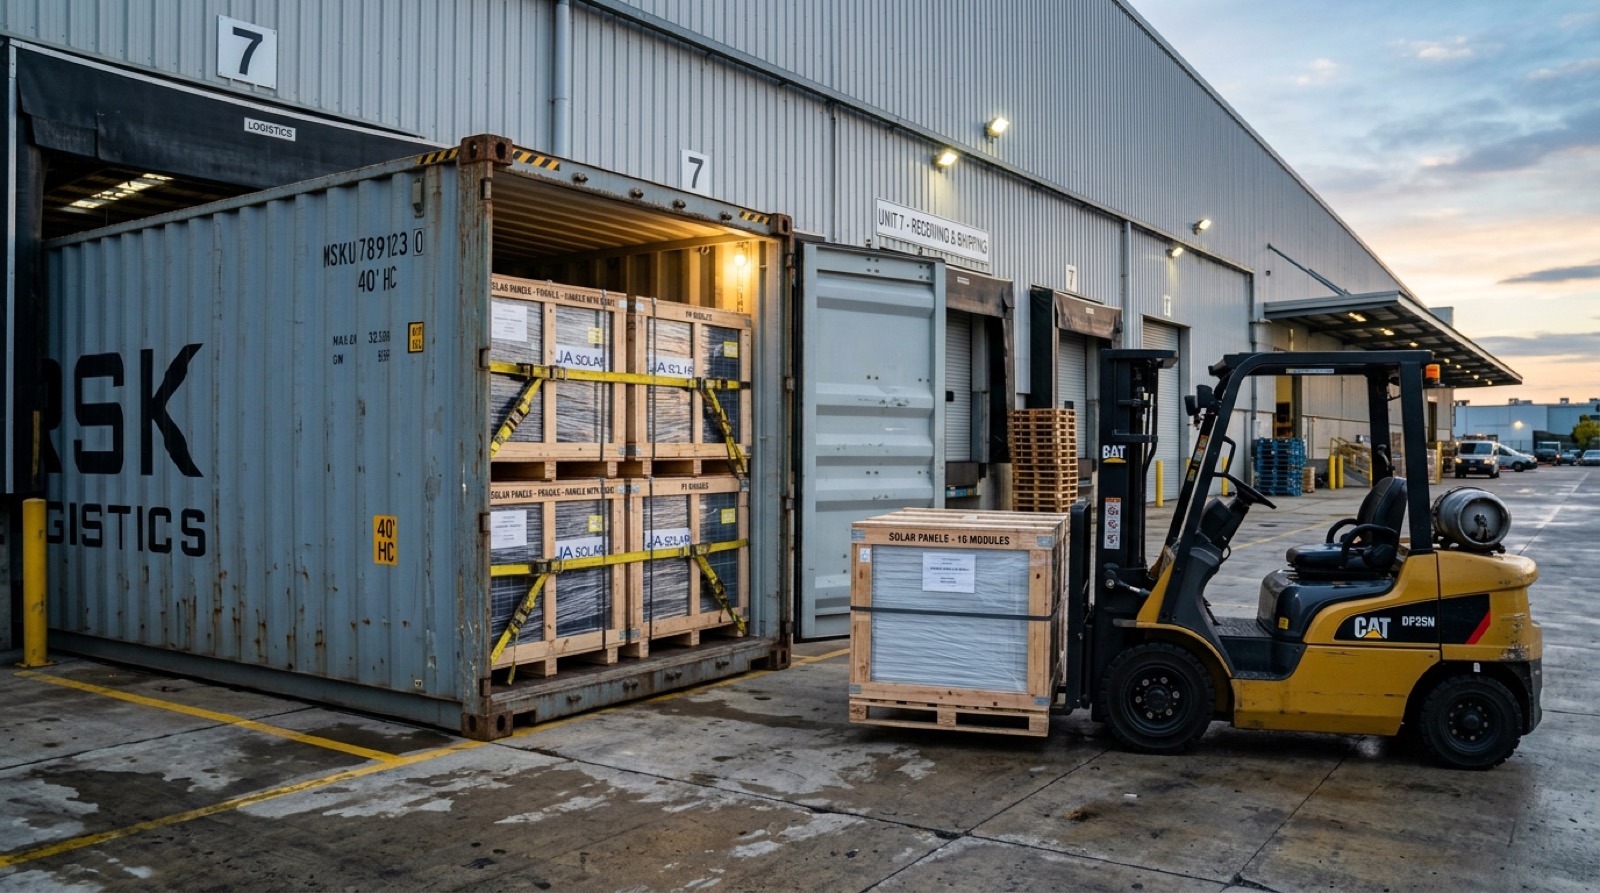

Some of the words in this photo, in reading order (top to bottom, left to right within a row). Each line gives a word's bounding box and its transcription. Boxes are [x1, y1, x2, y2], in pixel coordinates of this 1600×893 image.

[232, 26, 263, 75] 7
[248, 121, 293, 138] LOGISTICS
[688, 156, 704, 189] 7
[878, 208, 898, 229] UNIT
[899, 214, 905, 230] 7
[415, 230, 423, 254] 0
[358, 268, 380, 293] 40'
[383, 265, 397, 291] HC
[556, 350, 574, 365] JA
[377, 518, 395, 539] 40'
[889, 532, 916, 542] SOLAR
[969, 535, 1010, 545] MODULES
[378, 541, 394, 562] HC
[1354, 616, 1391, 639] CAT
